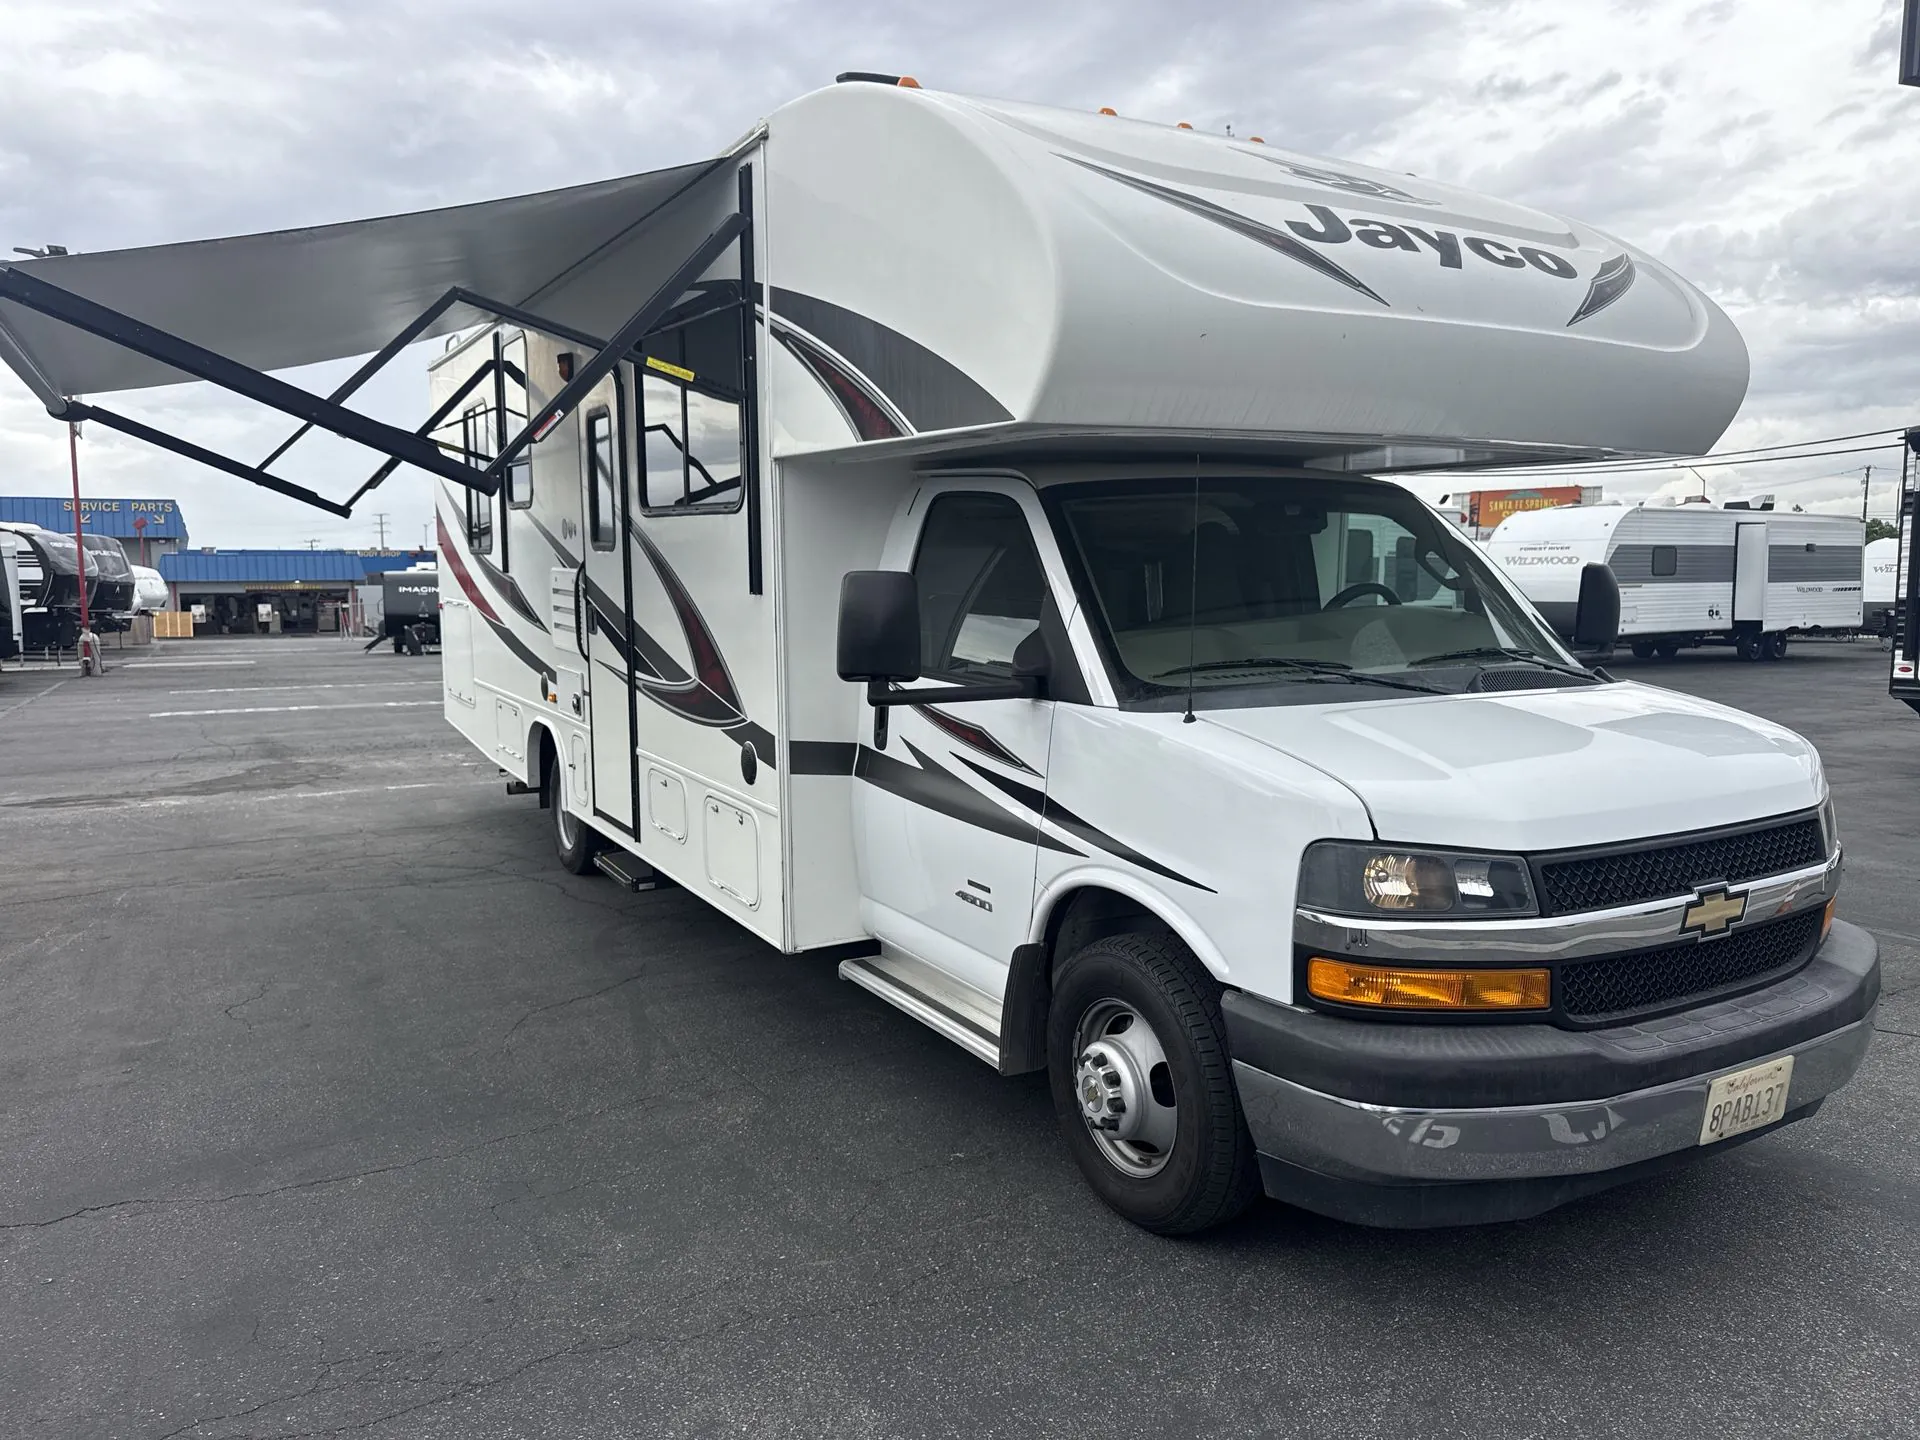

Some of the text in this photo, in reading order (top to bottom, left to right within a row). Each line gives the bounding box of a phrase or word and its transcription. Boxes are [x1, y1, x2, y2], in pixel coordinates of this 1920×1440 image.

[1284, 203, 1578, 280] Jayco
[131, 502, 173, 512] PARTS
[1489, 500, 1513, 512] SANTA
[1504, 556, 1580, 566] WILDWOOD
[1727, 1071, 1777, 1094] California
[1709, 1082, 1785, 1133] 8PAB137
